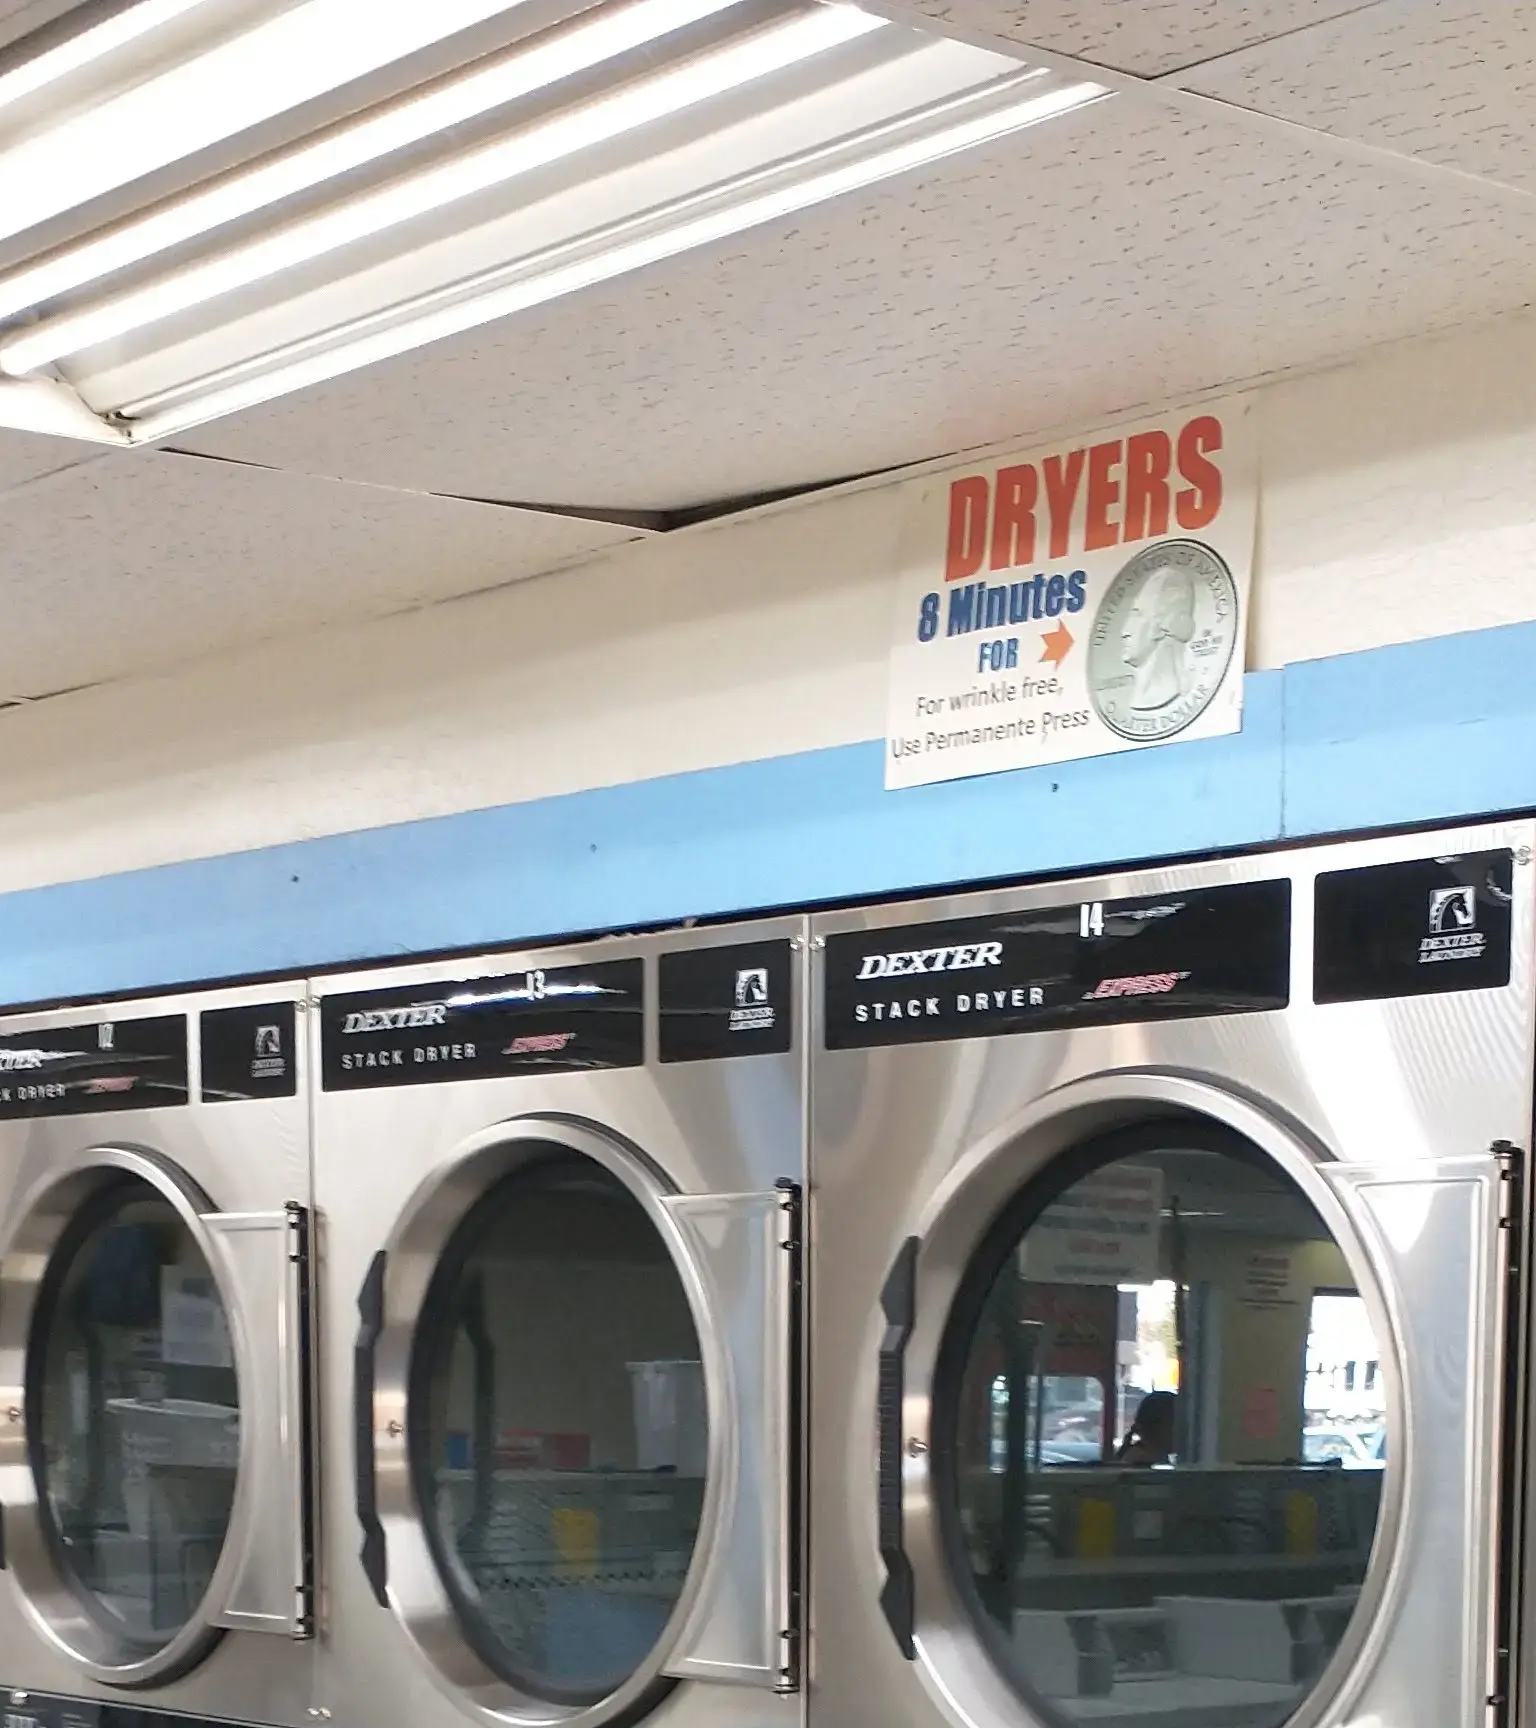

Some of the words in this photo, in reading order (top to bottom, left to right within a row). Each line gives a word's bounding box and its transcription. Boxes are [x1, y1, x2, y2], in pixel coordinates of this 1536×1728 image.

[945, 415, 1223, 582] DRYERS
[918, 592, 941, 643] 8
[946, 569, 1088, 637] Minutes
[977, 637, 1019, 674] FOR
[916, 696, 945, 718] For
[948, 680, 1017, 711] wrinkle
[1021, 676, 1064, 698] free,
[891, 735, 921, 760] Use
[925, 717, 1036, 752] Permanente
[1040, 709, 1091, 737] Press
[1080, 902, 1105, 938] 14
[855, 941, 1003, 980] DEXTER
[342, 1004, 446, 1034] DEXTER
[855, 997, 940, 1023] STACK
[956, 987, 1044, 1013] DRYER
[341, 1049, 403, 1070] STACK
[413, 1043, 477, 1063] DRYER
